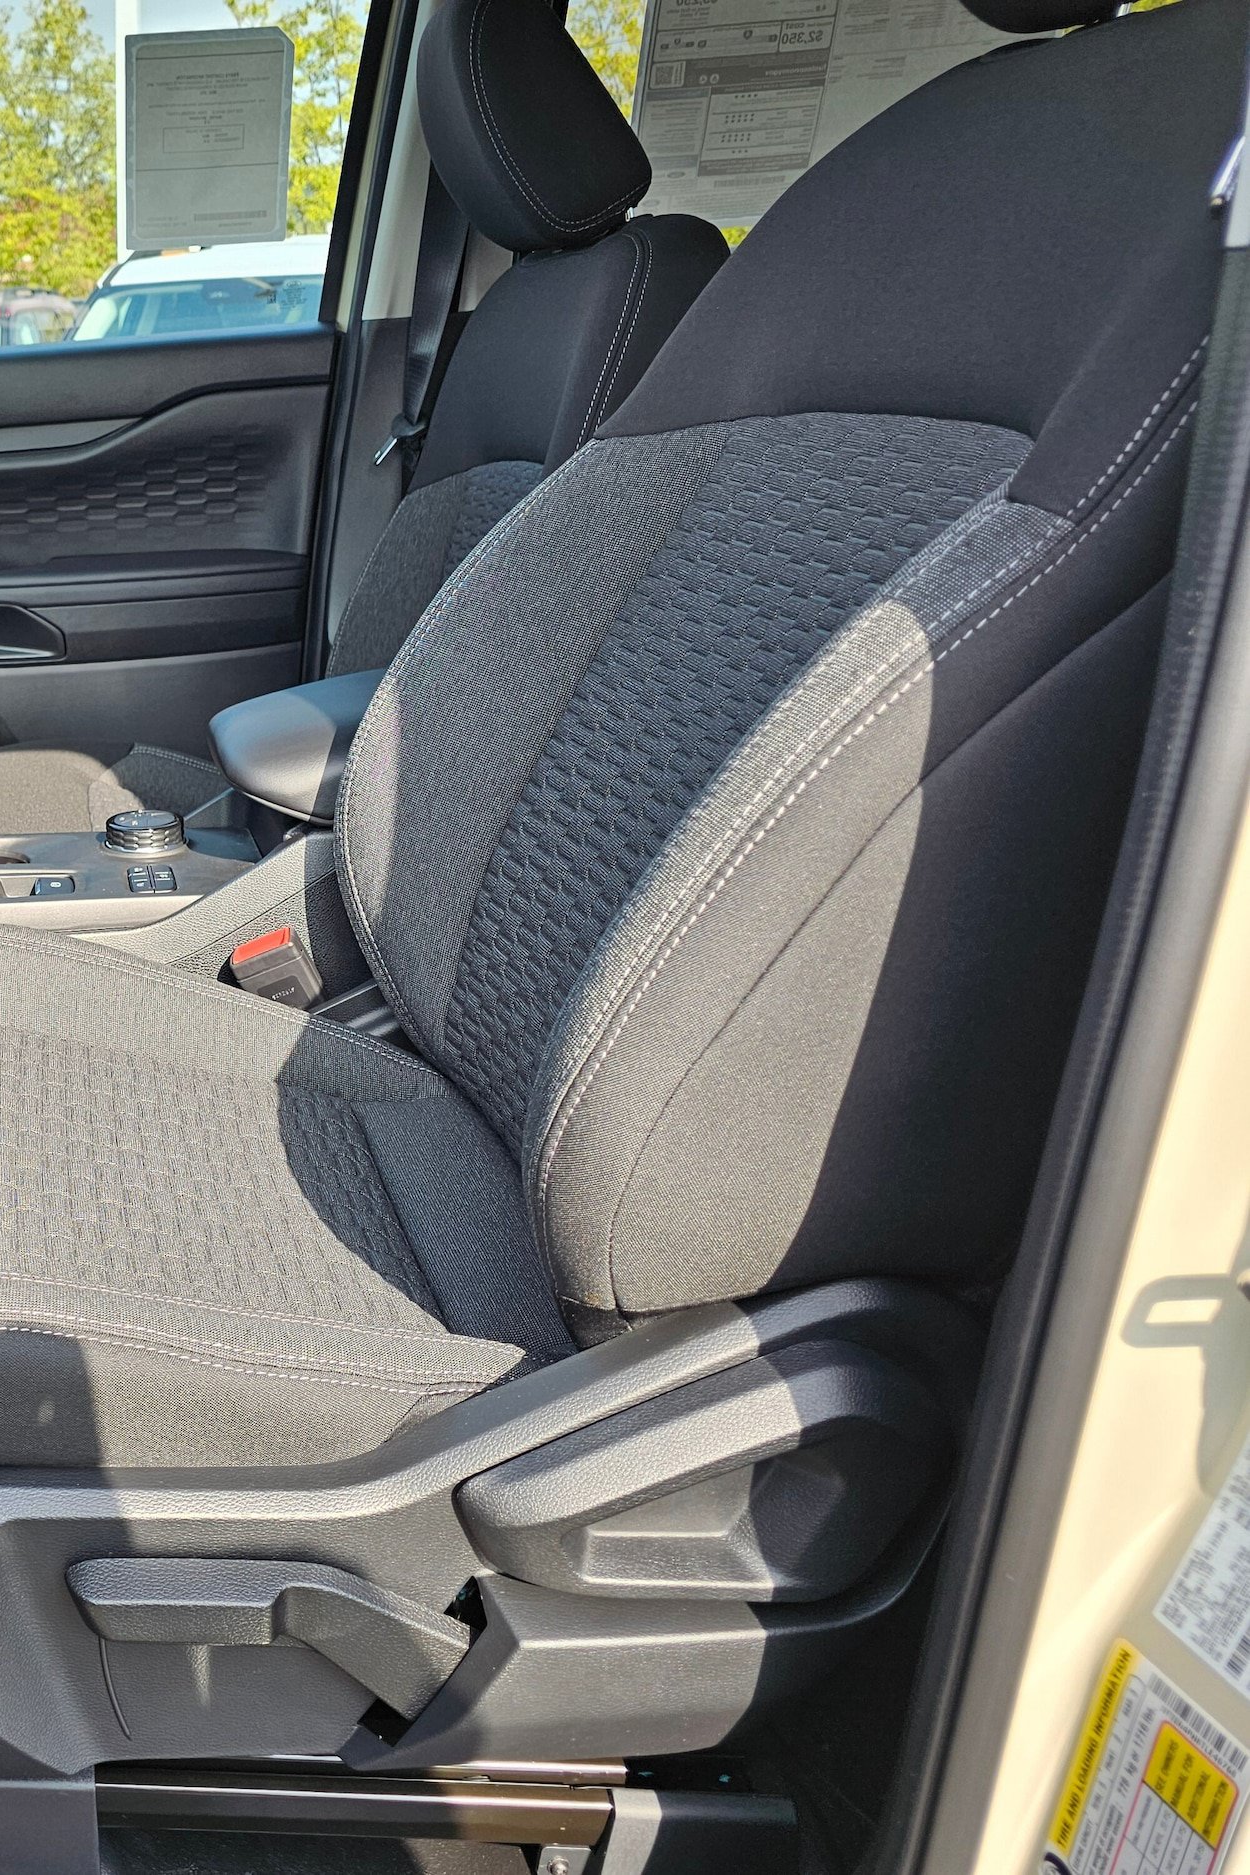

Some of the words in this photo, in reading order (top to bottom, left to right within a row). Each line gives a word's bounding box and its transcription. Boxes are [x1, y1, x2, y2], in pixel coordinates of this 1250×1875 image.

[1056, 1818, 1072, 1850] TIRE
[1066, 1791, 1081, 1821] AND
[1074, 1736, 1100, 1795] LOADING
[1092, 1647, 1133, 1738] INFORMATION
[1124, 1761, 1138, 1777] kg
